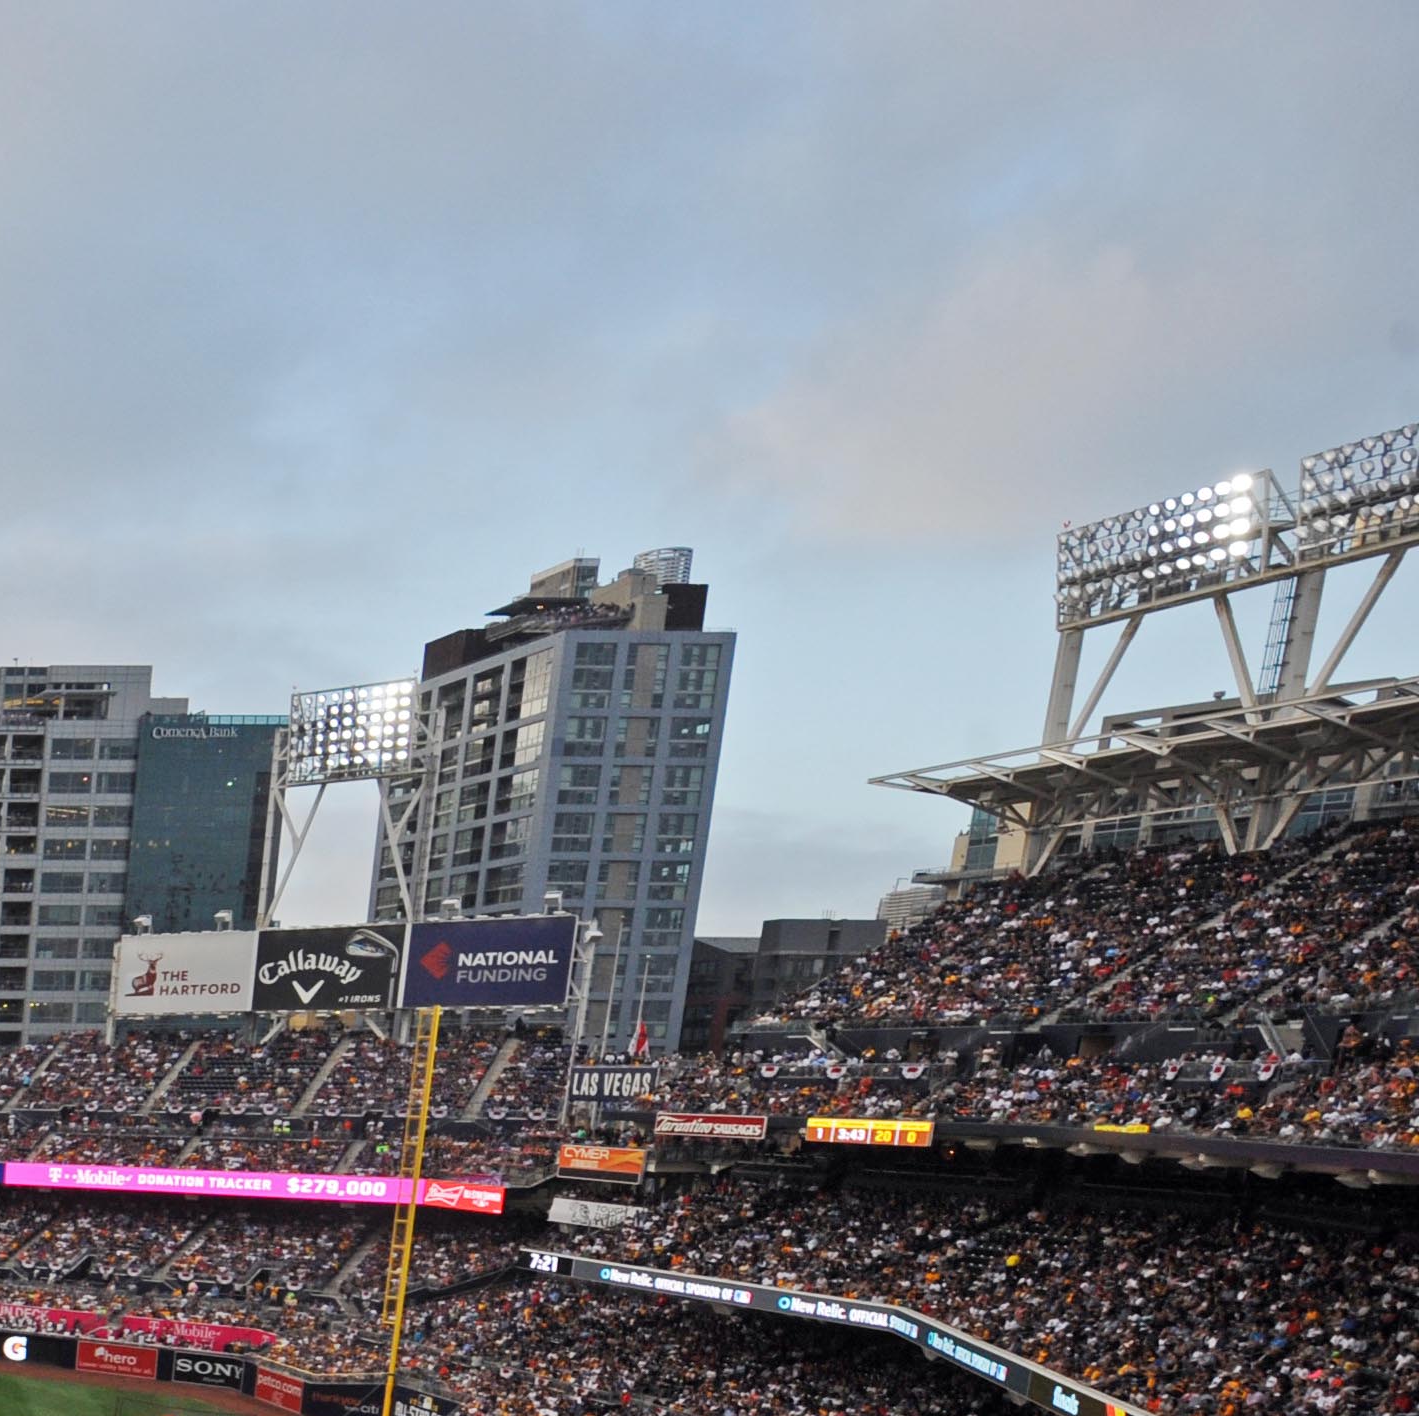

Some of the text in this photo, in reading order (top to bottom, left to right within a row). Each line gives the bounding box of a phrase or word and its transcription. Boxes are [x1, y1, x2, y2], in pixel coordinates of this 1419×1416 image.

[209, 726, 238, 738] Bank
[258, 948, 363, 985] Callaway
[457, 949, 559, 967] NATIONAL
[162, 970, 188, 982] THE
[456, 966, 548, 984] FUNDING
[159, 982, 241, 997] HARTFORD
[350, 993, 381, 1003] IRONS
[572, 1072, 651, 1098] LAS VEGAS
[656, 1115, 712, 1135] Tarantino
[837, 1127, 866, 1141] 3:43
[874, 1129, 892, 1142] 20
[563, 1147, 610, 1161] CYMER
[137, 1173, 206, 1189] DONATION
[208, 1176, 272, 1191] TRACKER
[286, 1177, 387, 1199] $279,000
[529, 1252, 559, 1272] 7:21
[610, 1267, 629, 1284] New
[790, 1297, 815, 1315] New
[849, 1308, 889, 1328] OFFICIAL
[3, 1336, 28, 1361] G
[103, 1349, 137, 1366] hero
[175, 1357, 244, 1379] SONY
[257, 1373, 302, 1398] petco.com
[360, 1404, 379, 1415] citi
